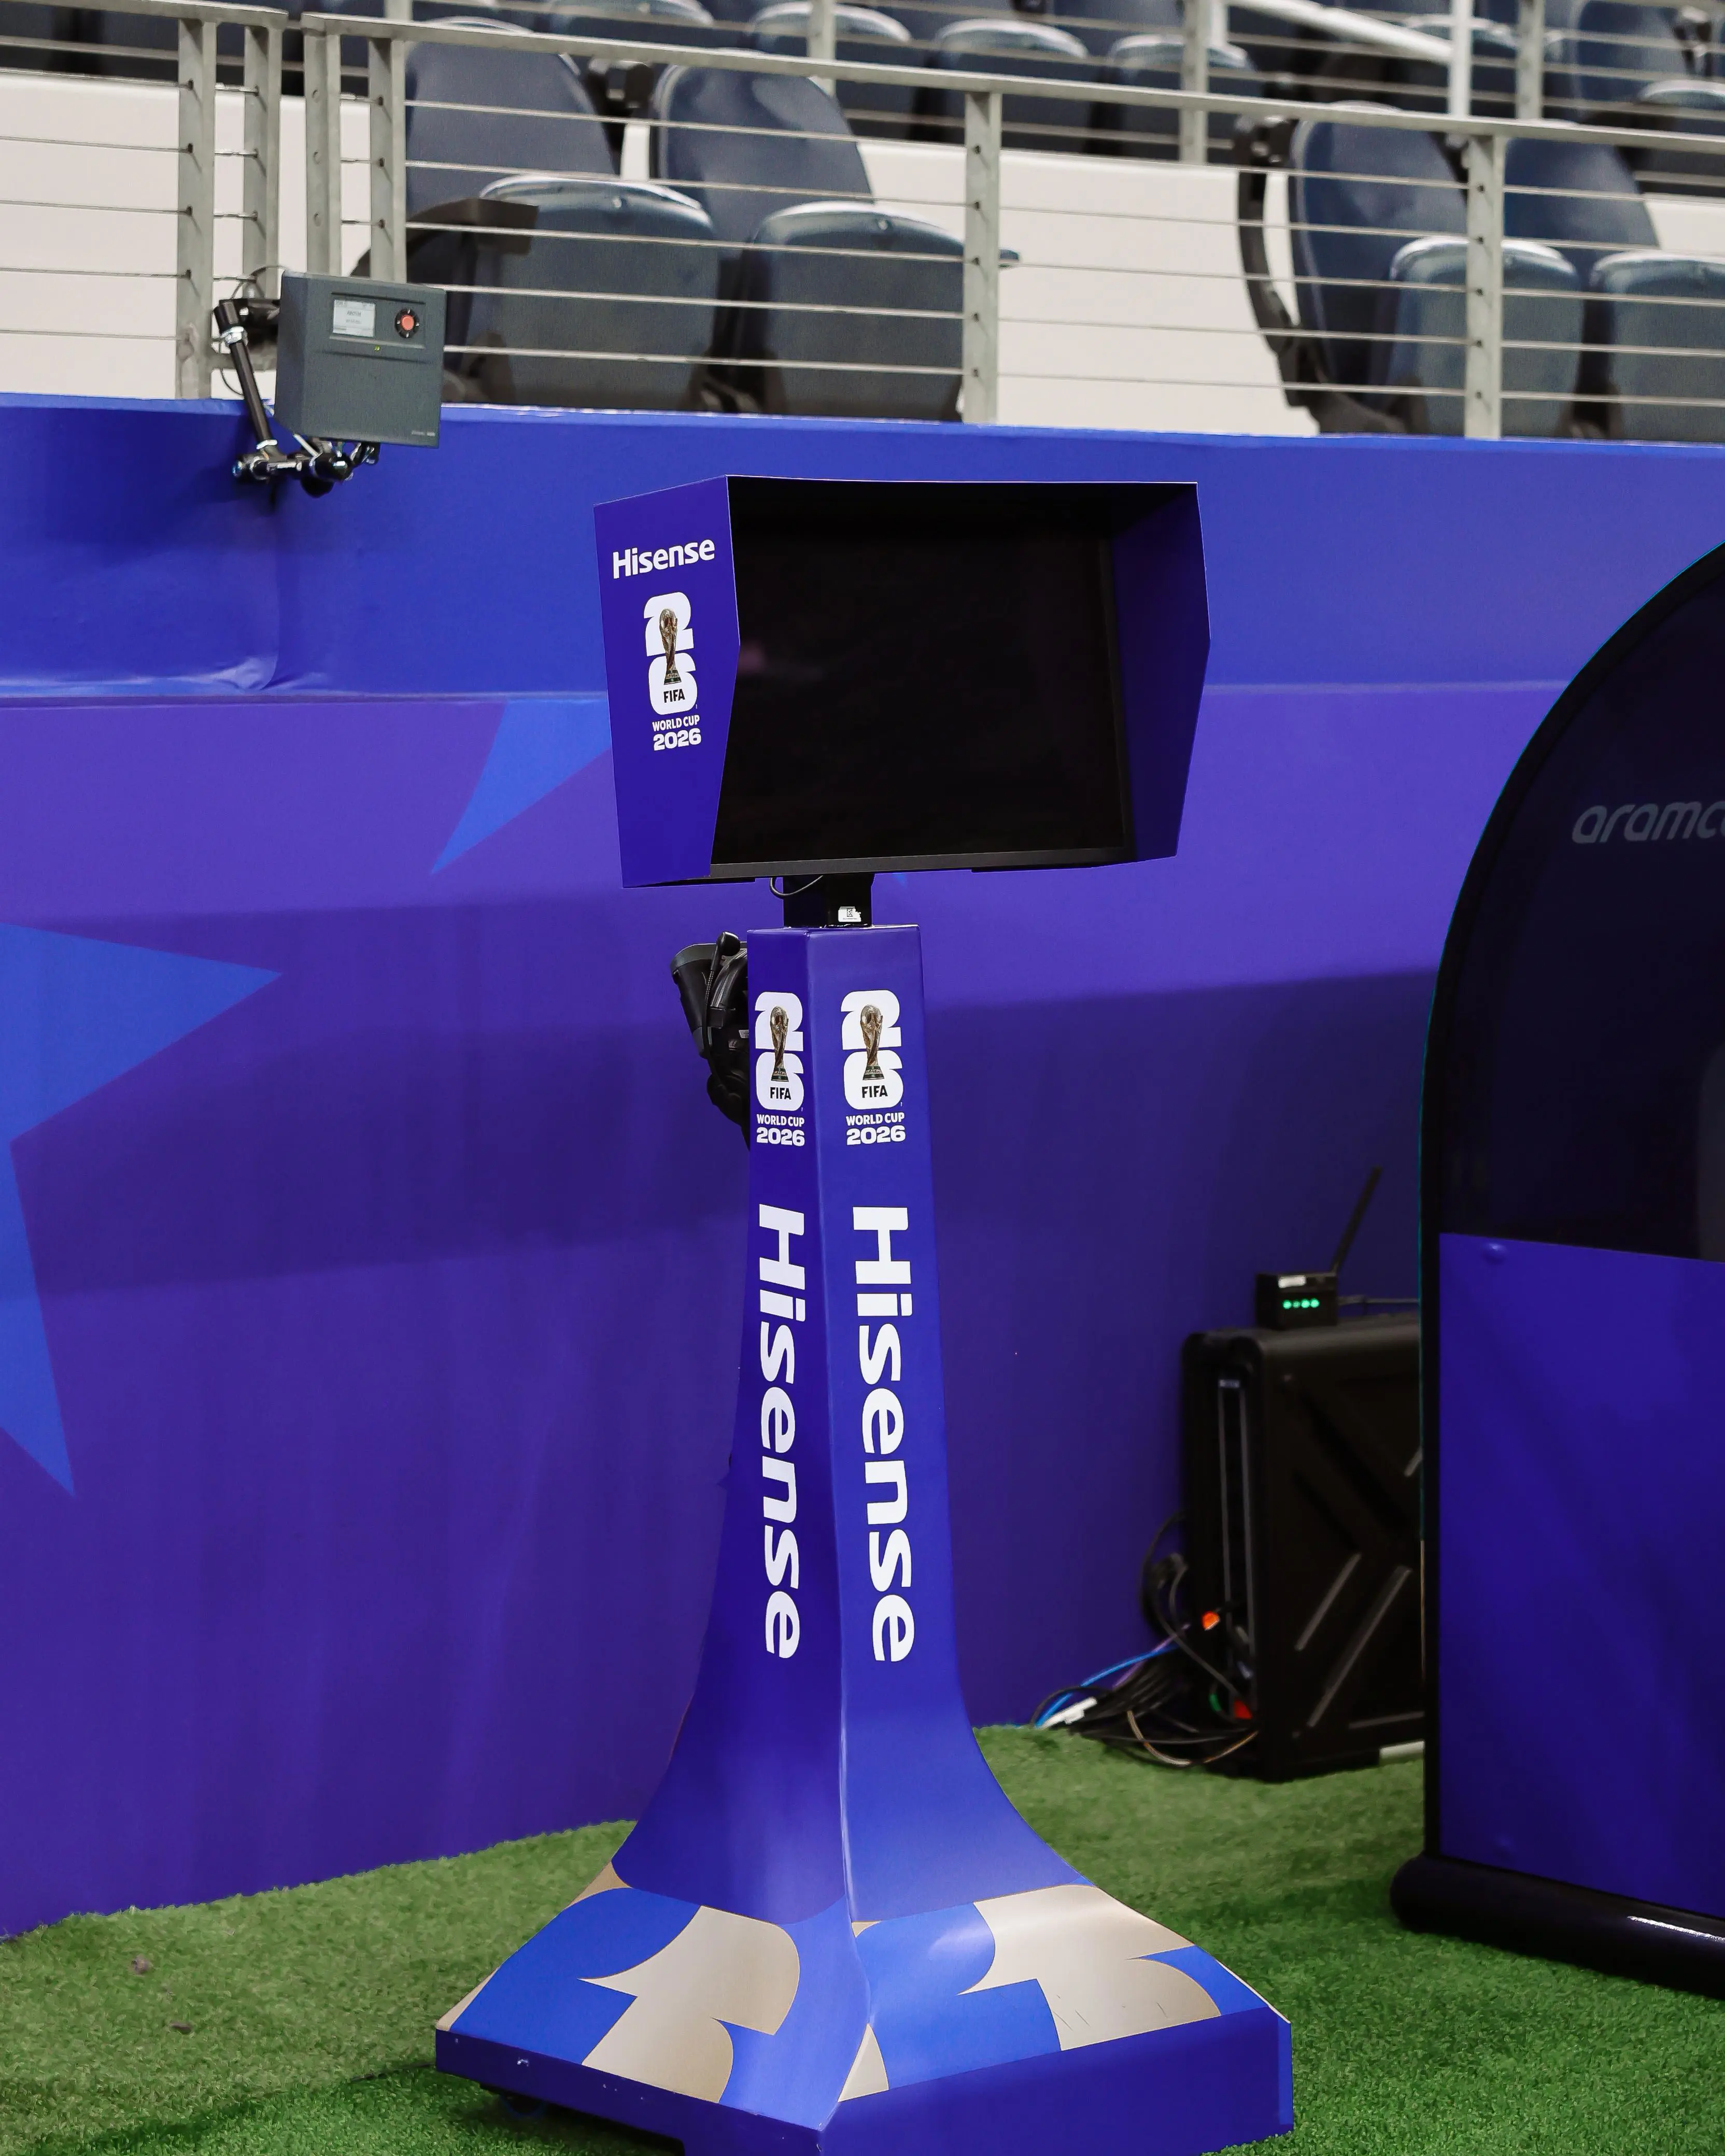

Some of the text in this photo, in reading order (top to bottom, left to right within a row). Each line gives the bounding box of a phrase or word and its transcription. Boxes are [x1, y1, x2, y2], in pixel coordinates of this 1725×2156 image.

[613, 539, 715, 579] Hisense
[663, 688, 685, 703] FIFA
[652, 715, 700, 732] WORLD CUP
[653, 728, 701, 751] 2026
[1572, 801, 1725, 844] aramc
[770, 1087, 791, 1100] FIFA
[861, 1085, 888, 1098] FIFA
[756, 1114, 805, 1127] WORLD CUP
[845, 1112, 904, 1126] WORLD CUP
[756, 1127, 805, 1146] 2026
[846, 1125, 906, 1145] 2026
[759, 1203, 805, 1658] Hisense
[853, 1207, 914, 1662] Hisense
